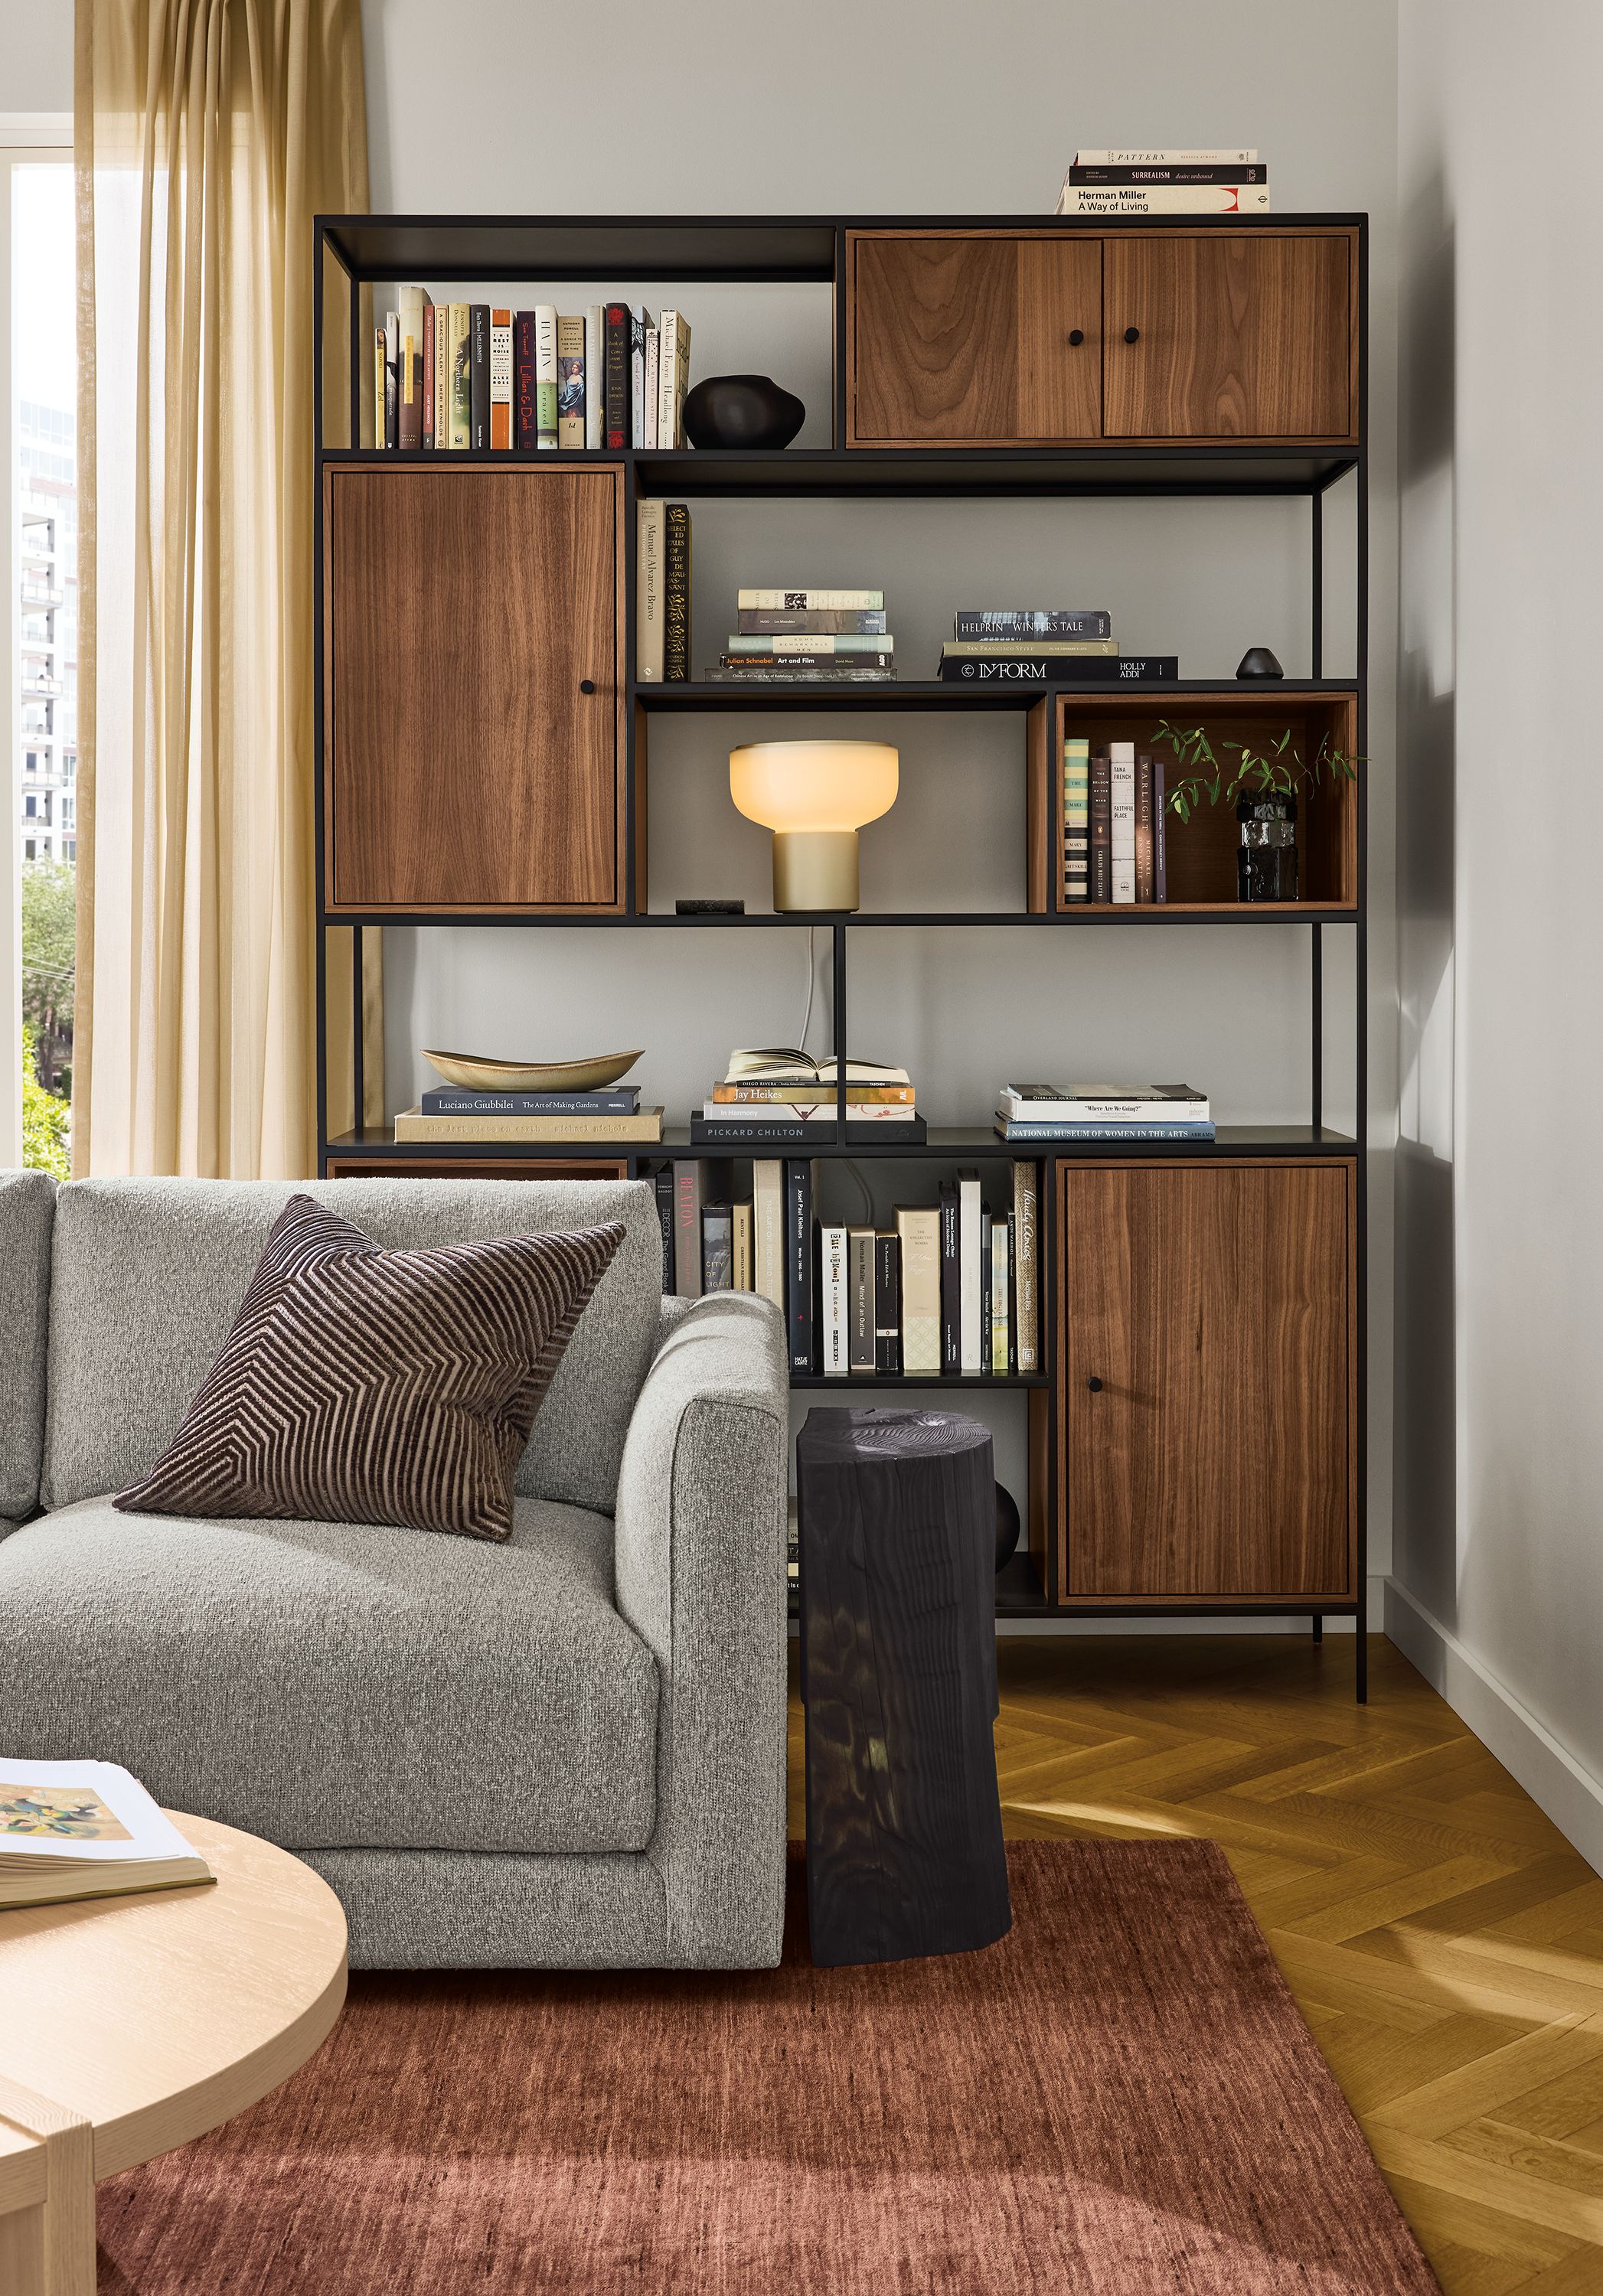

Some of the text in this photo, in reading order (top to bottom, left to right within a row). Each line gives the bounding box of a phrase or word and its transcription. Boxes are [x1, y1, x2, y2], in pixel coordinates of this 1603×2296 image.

[1078, 202, 1148, 213] A Way of Living
[540, 321, 550, 367] HA JIN
[455, 357, 464, 392] Northern
[521, 365, 532, 393] Lillian
[661, 317, 674, 424] Michael Frayn Headlong
[455, 393, 464, 414] Light
[521, 407, 532, 431] Dash
[648, 524, 657, 620] Manuel Alvarez Bravo
[961, 622, 1083, 632] HELPRIN WINTER'S TALE
[439, 1100, 514, 1109] Luciano Giubbilei
[553, 1101, 575, 1110] Making
[734, 1089, 782, 1101] Jay Heikes
[680, 1178, 694, 1228] BEATON
[662, 1213, 671, 1238] DECOR
[662, 1240, 671, 1251] The
[662, 1252, 671, 1272] Grand
[662, 1273, 671, 1287] Book
